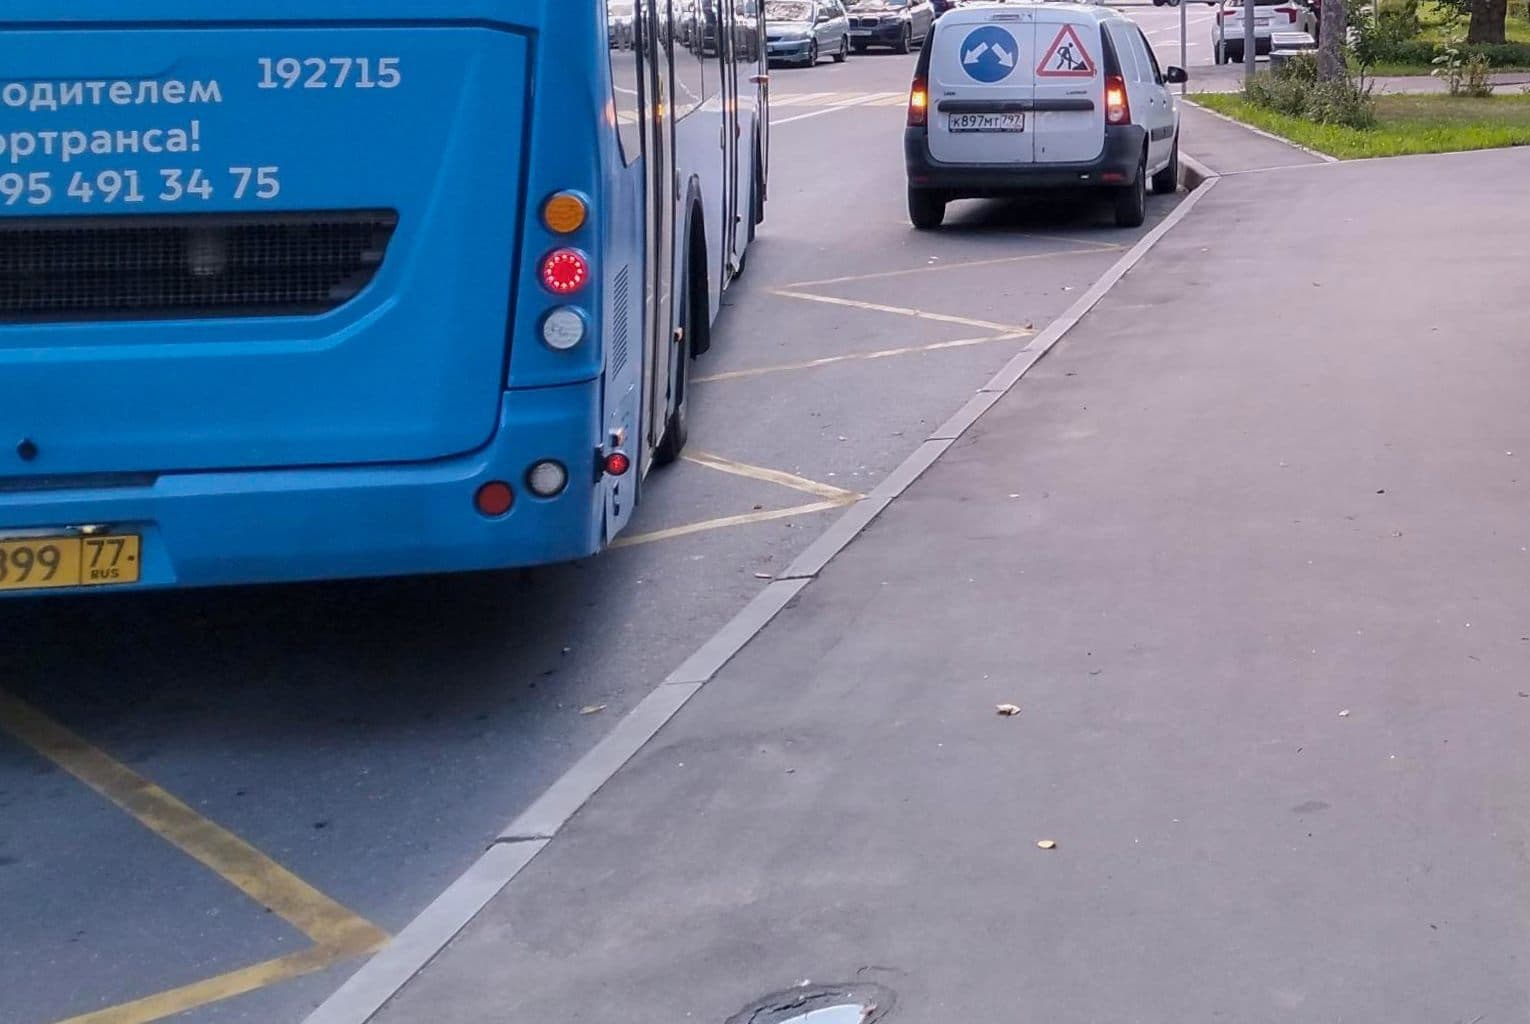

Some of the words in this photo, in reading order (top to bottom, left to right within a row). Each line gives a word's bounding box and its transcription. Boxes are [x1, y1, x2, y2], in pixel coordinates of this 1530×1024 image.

[257, 57, 402, 90] 192715
[2, 79, 223, 112] одителем
[0, 120, 201, 164] ртранса!
[0, 171, 53, 206] 95
[66, 169, 145, 204] 491
[158, 168, 214, 202] 34
[228, 166, 281, 200] 75
[85, 538, 126, 567] 77
[90, 568, 120, 579] RUS
